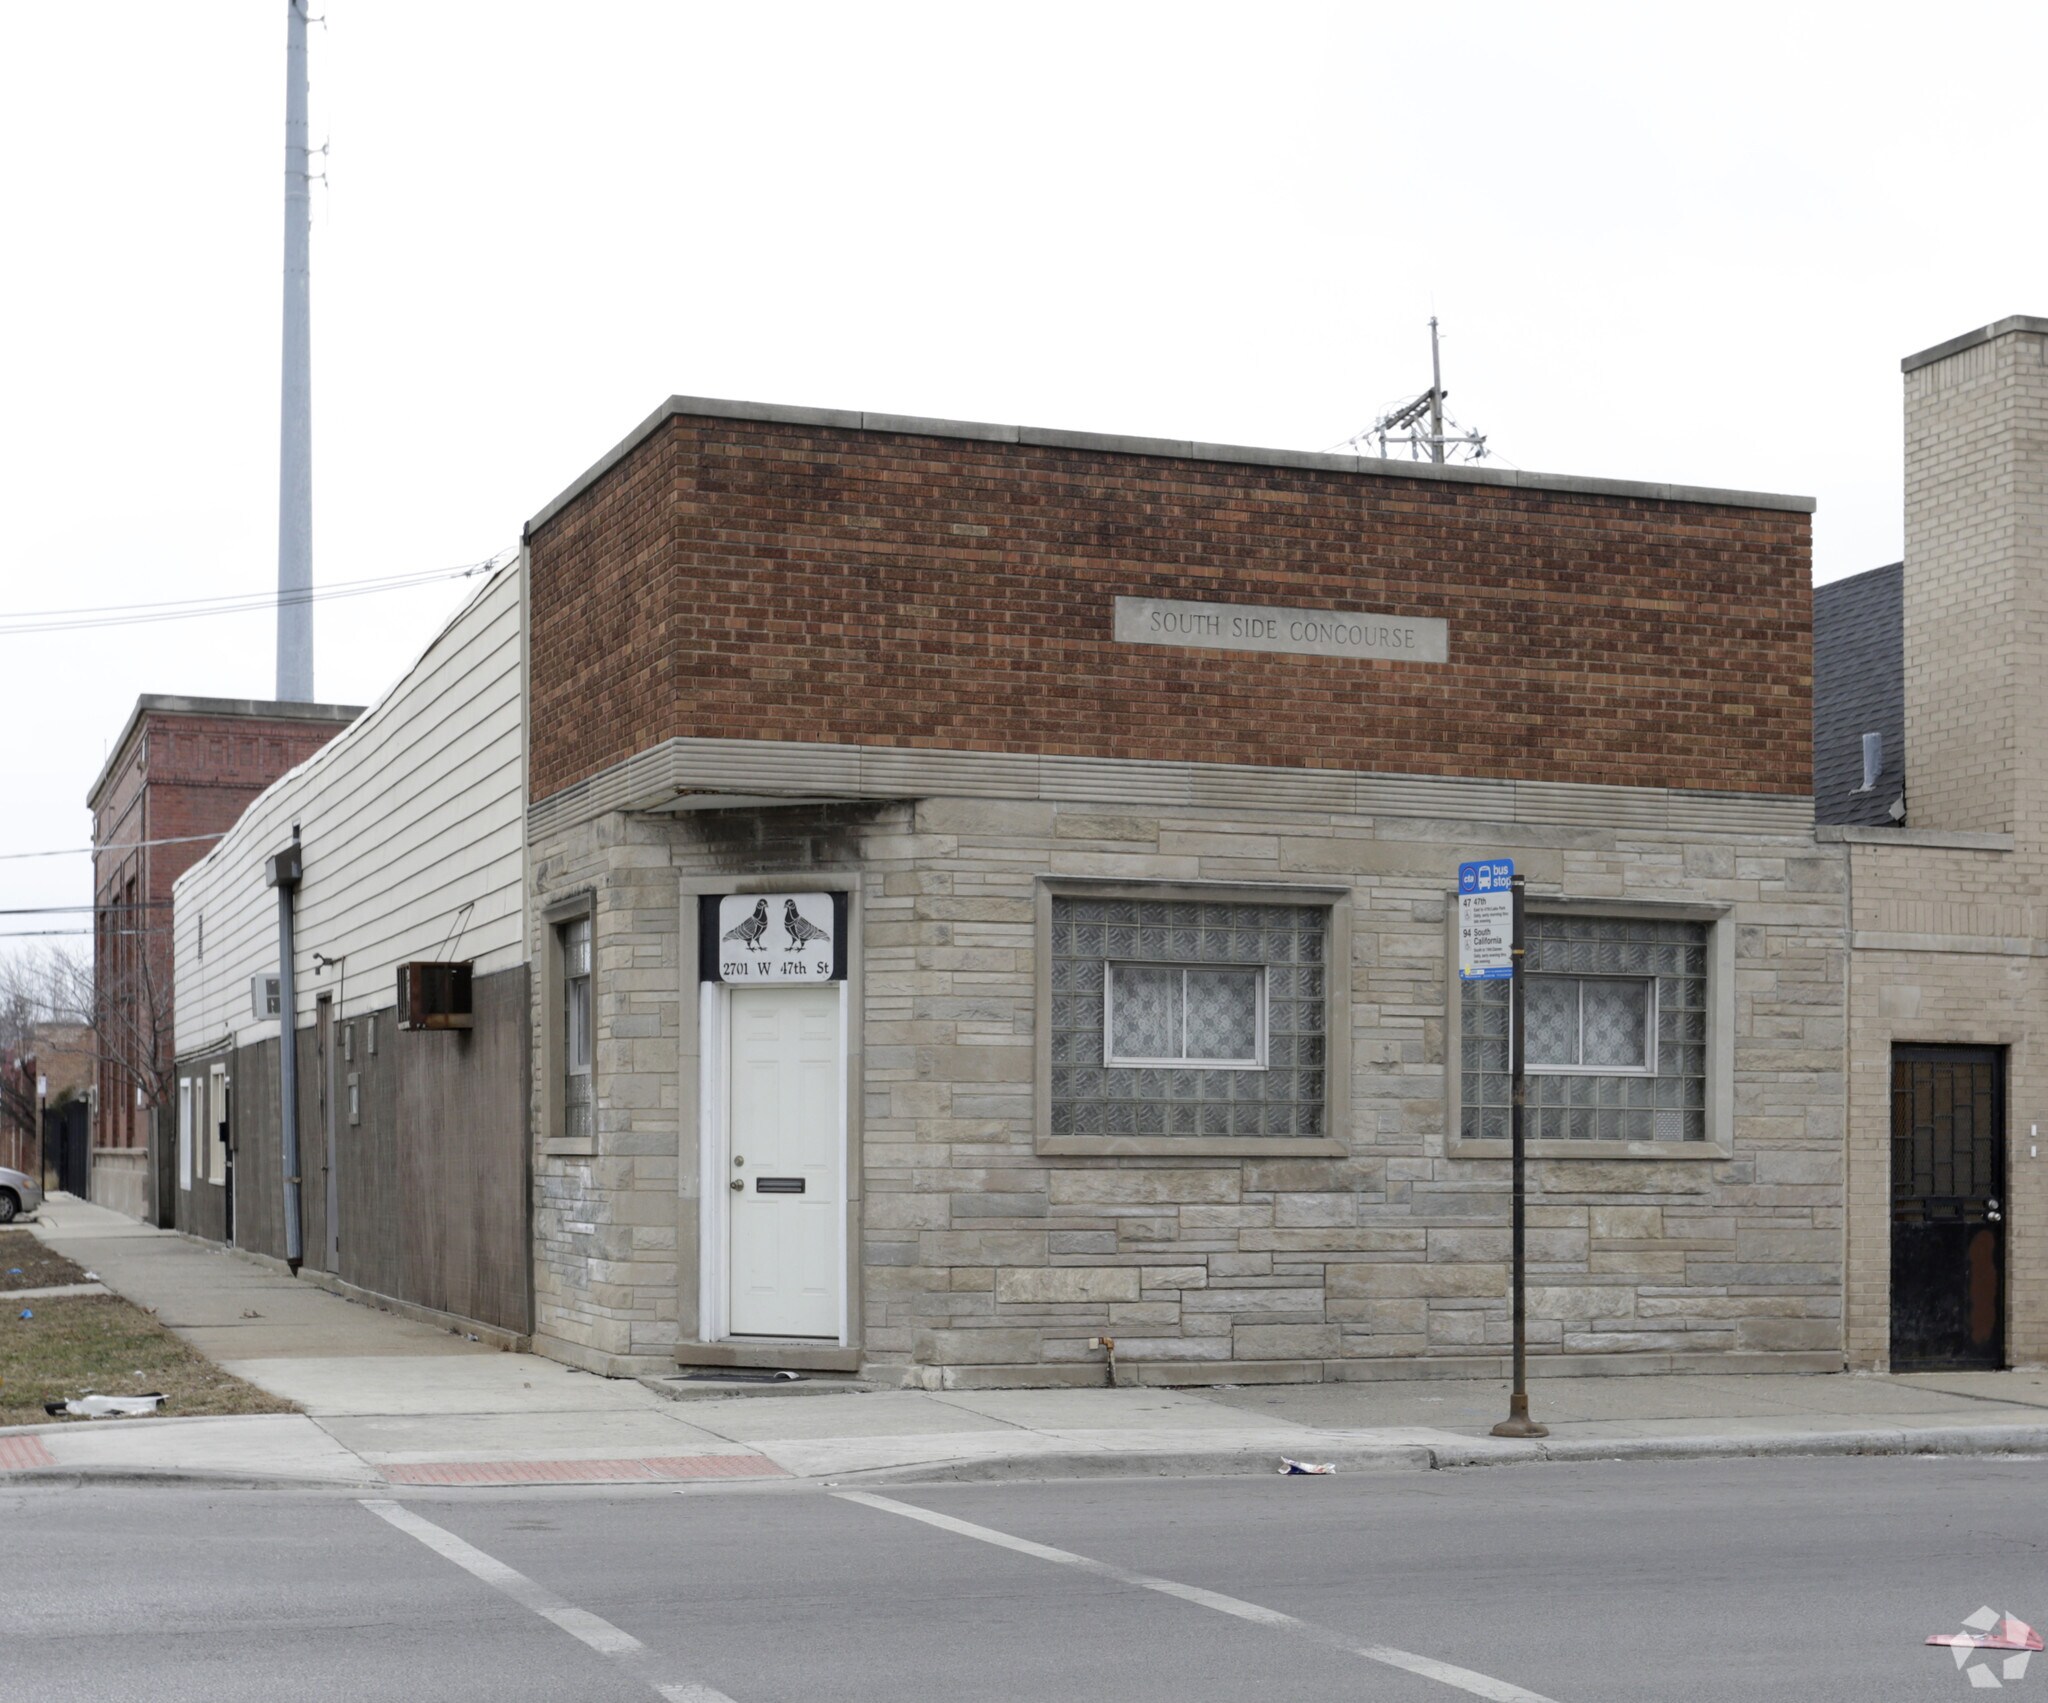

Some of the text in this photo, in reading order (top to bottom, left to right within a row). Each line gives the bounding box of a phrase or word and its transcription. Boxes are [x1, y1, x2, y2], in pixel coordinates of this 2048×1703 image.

[1150, 611, 1415, 649] SOUTH SIDE CONCOURSE
[1493, 865, 1508, 875] bus
[1493, 876, 1511, 889] stop
[1463, 897, 1486, 907] 47 47th
[1463, 928, 1491, 938] 94 South
[1474, 937, 1502, 945] California
[723, 961, 830, 976] 2701 W 47th St
